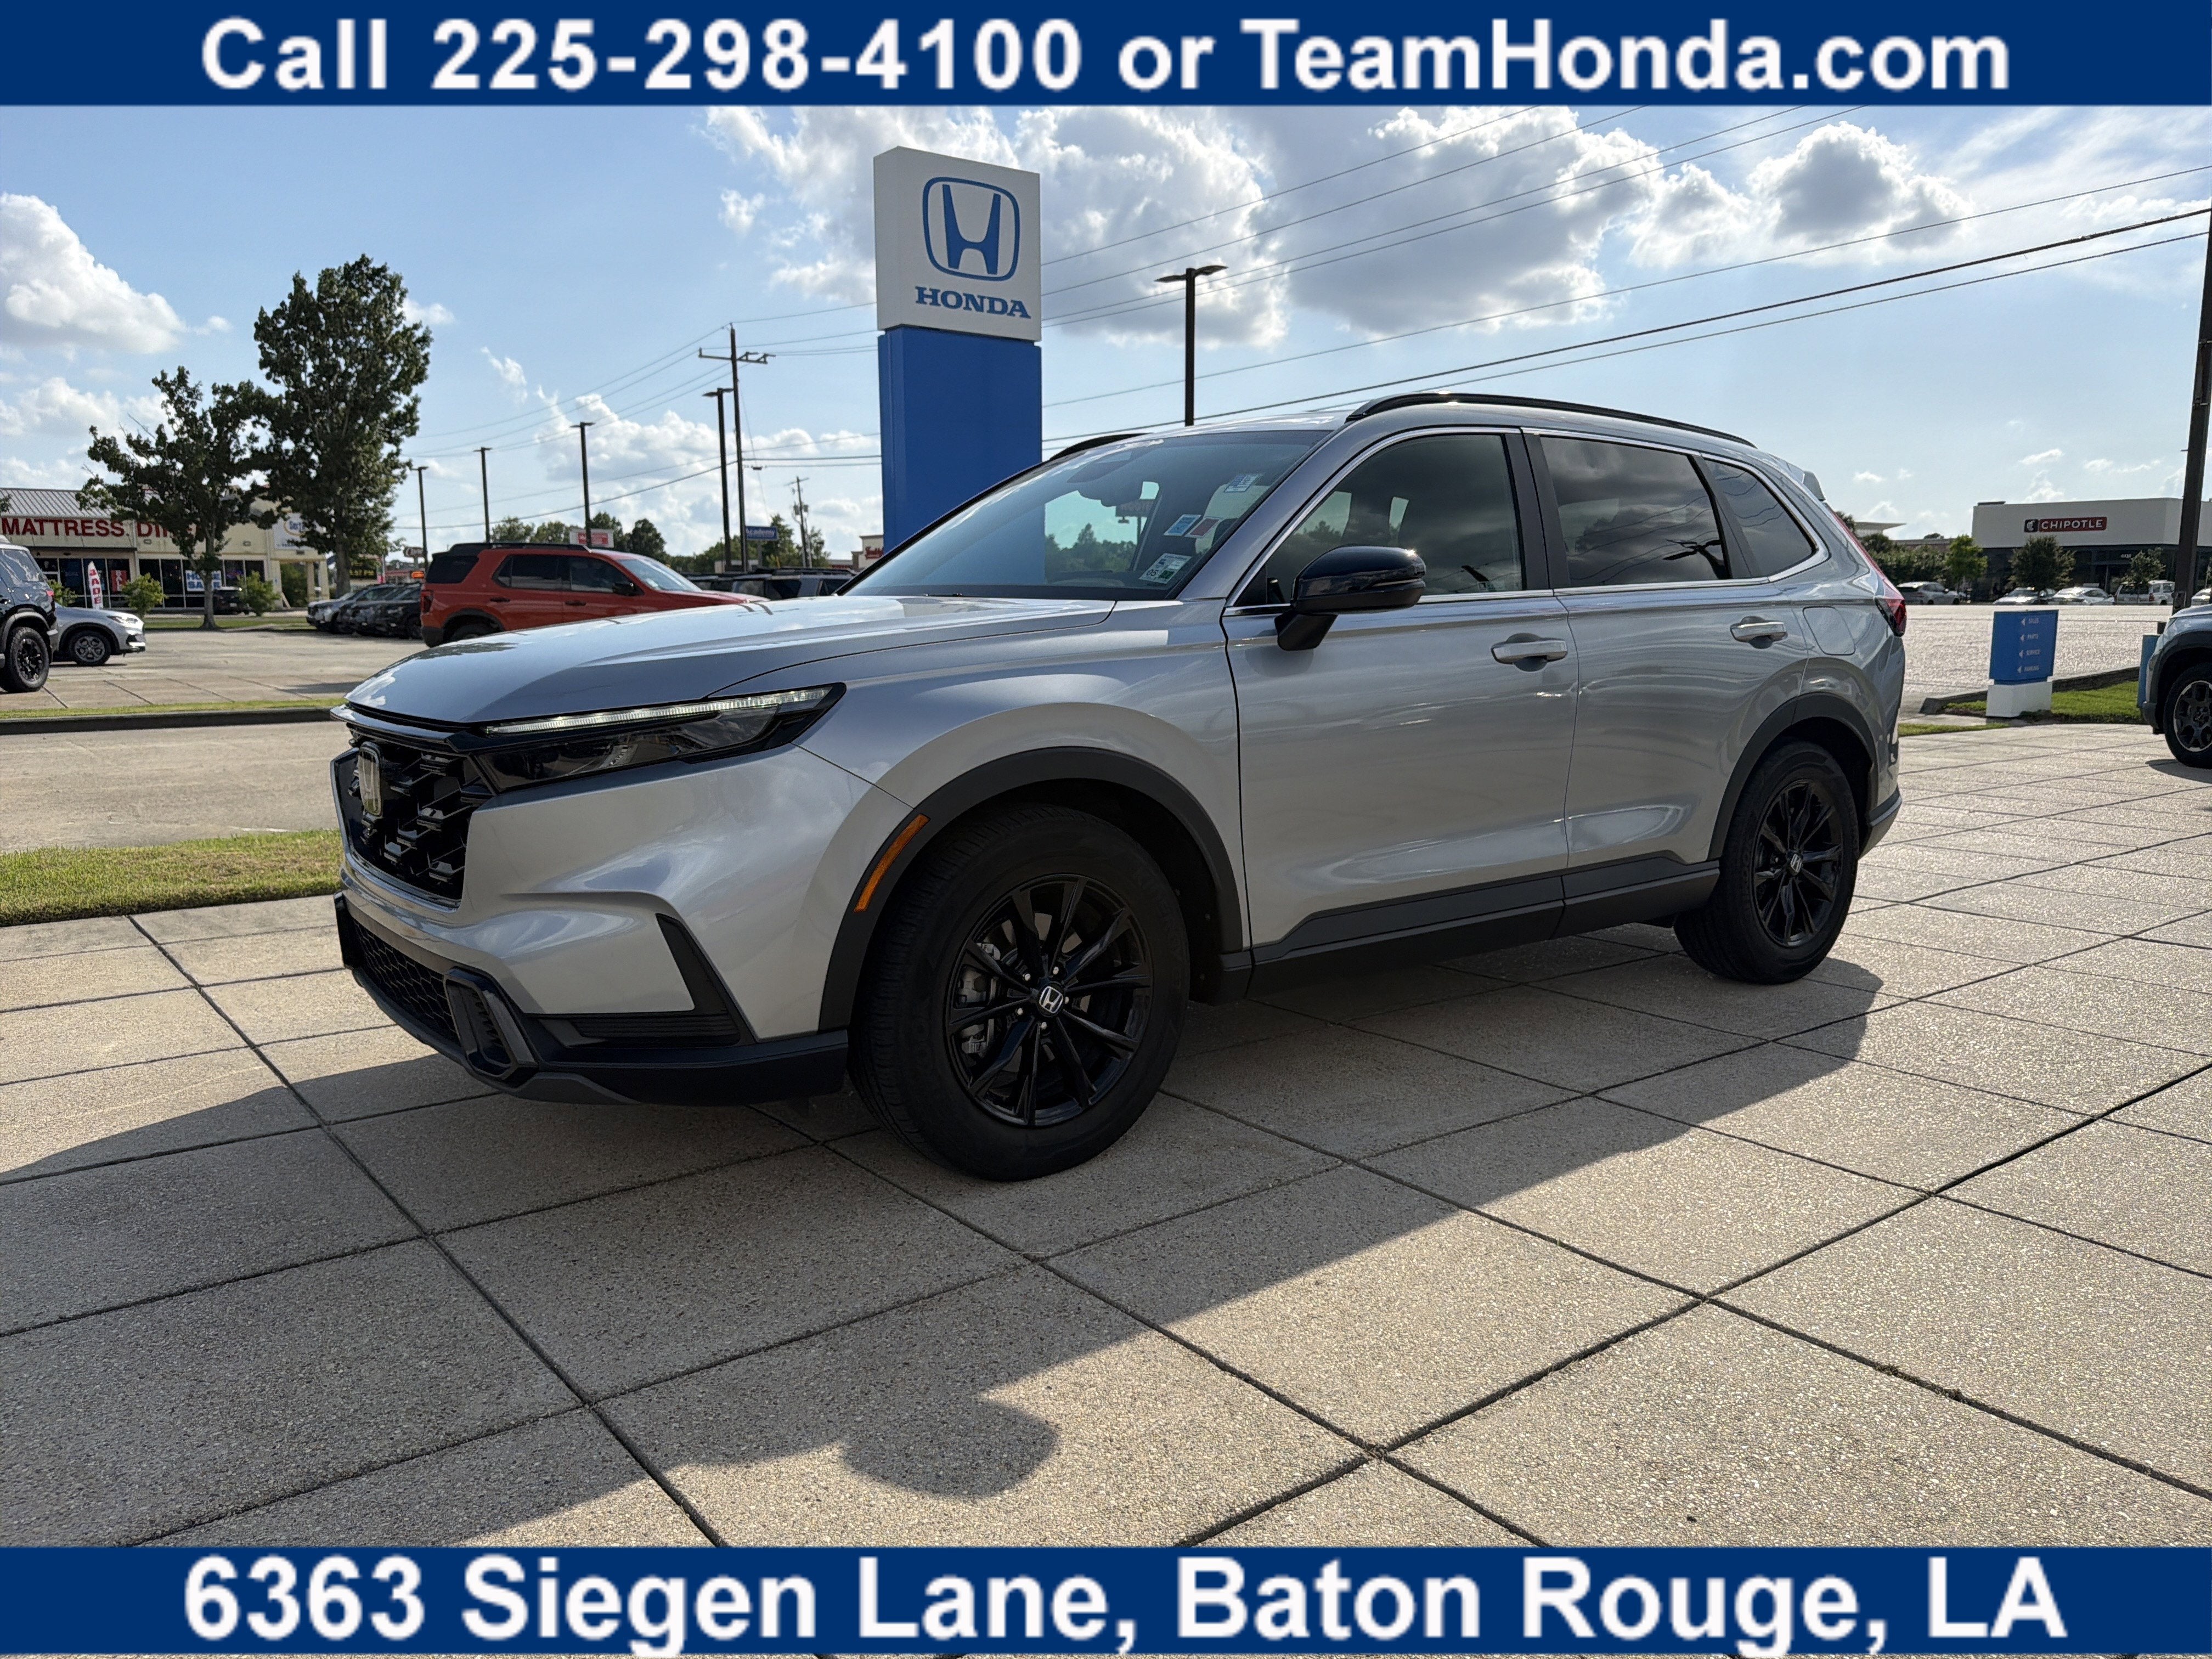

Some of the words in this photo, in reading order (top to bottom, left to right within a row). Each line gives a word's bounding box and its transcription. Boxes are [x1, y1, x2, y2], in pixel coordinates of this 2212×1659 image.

[915, 286, 1031, 319] HONDA
[2, 518, 125, 537] MATTRESS
[2041, 519, 2103, 530] CHIPOTLE
